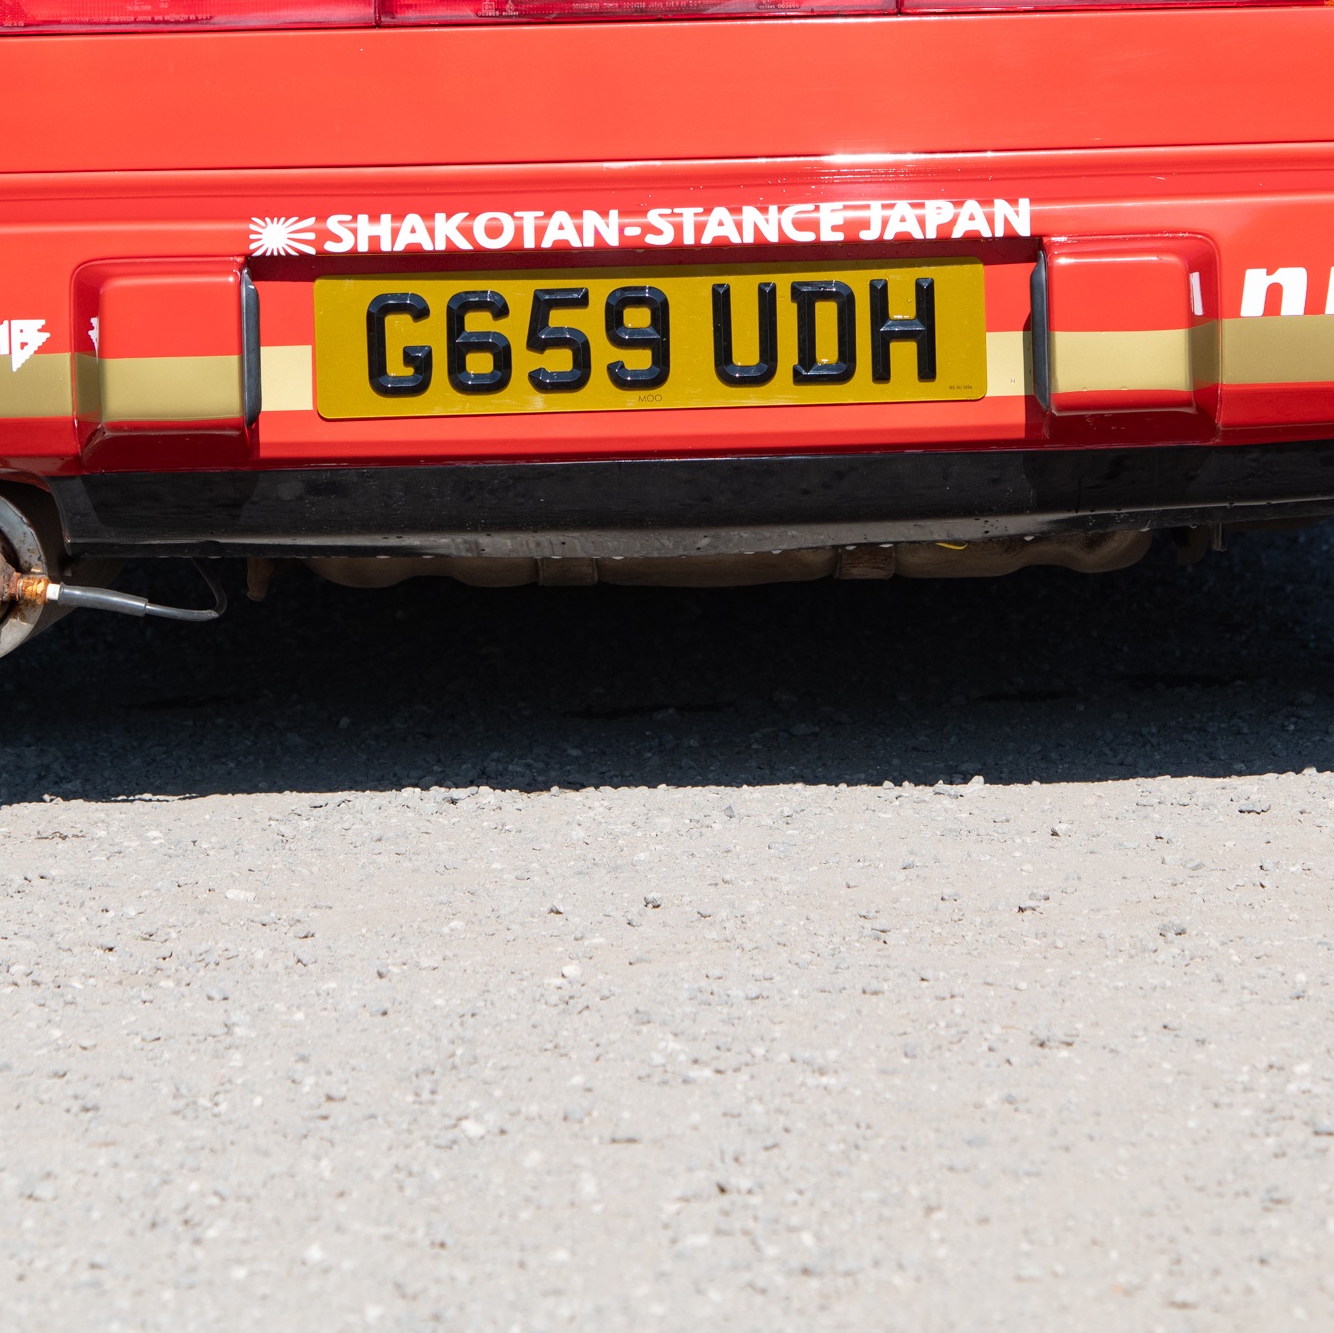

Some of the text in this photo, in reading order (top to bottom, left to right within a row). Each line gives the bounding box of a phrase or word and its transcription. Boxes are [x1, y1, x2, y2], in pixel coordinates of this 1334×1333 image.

[323, 198, 1032, 254] SHAKOTAN-STANCE JAPAN
[365, 277, 937, 399] G659 UDH
